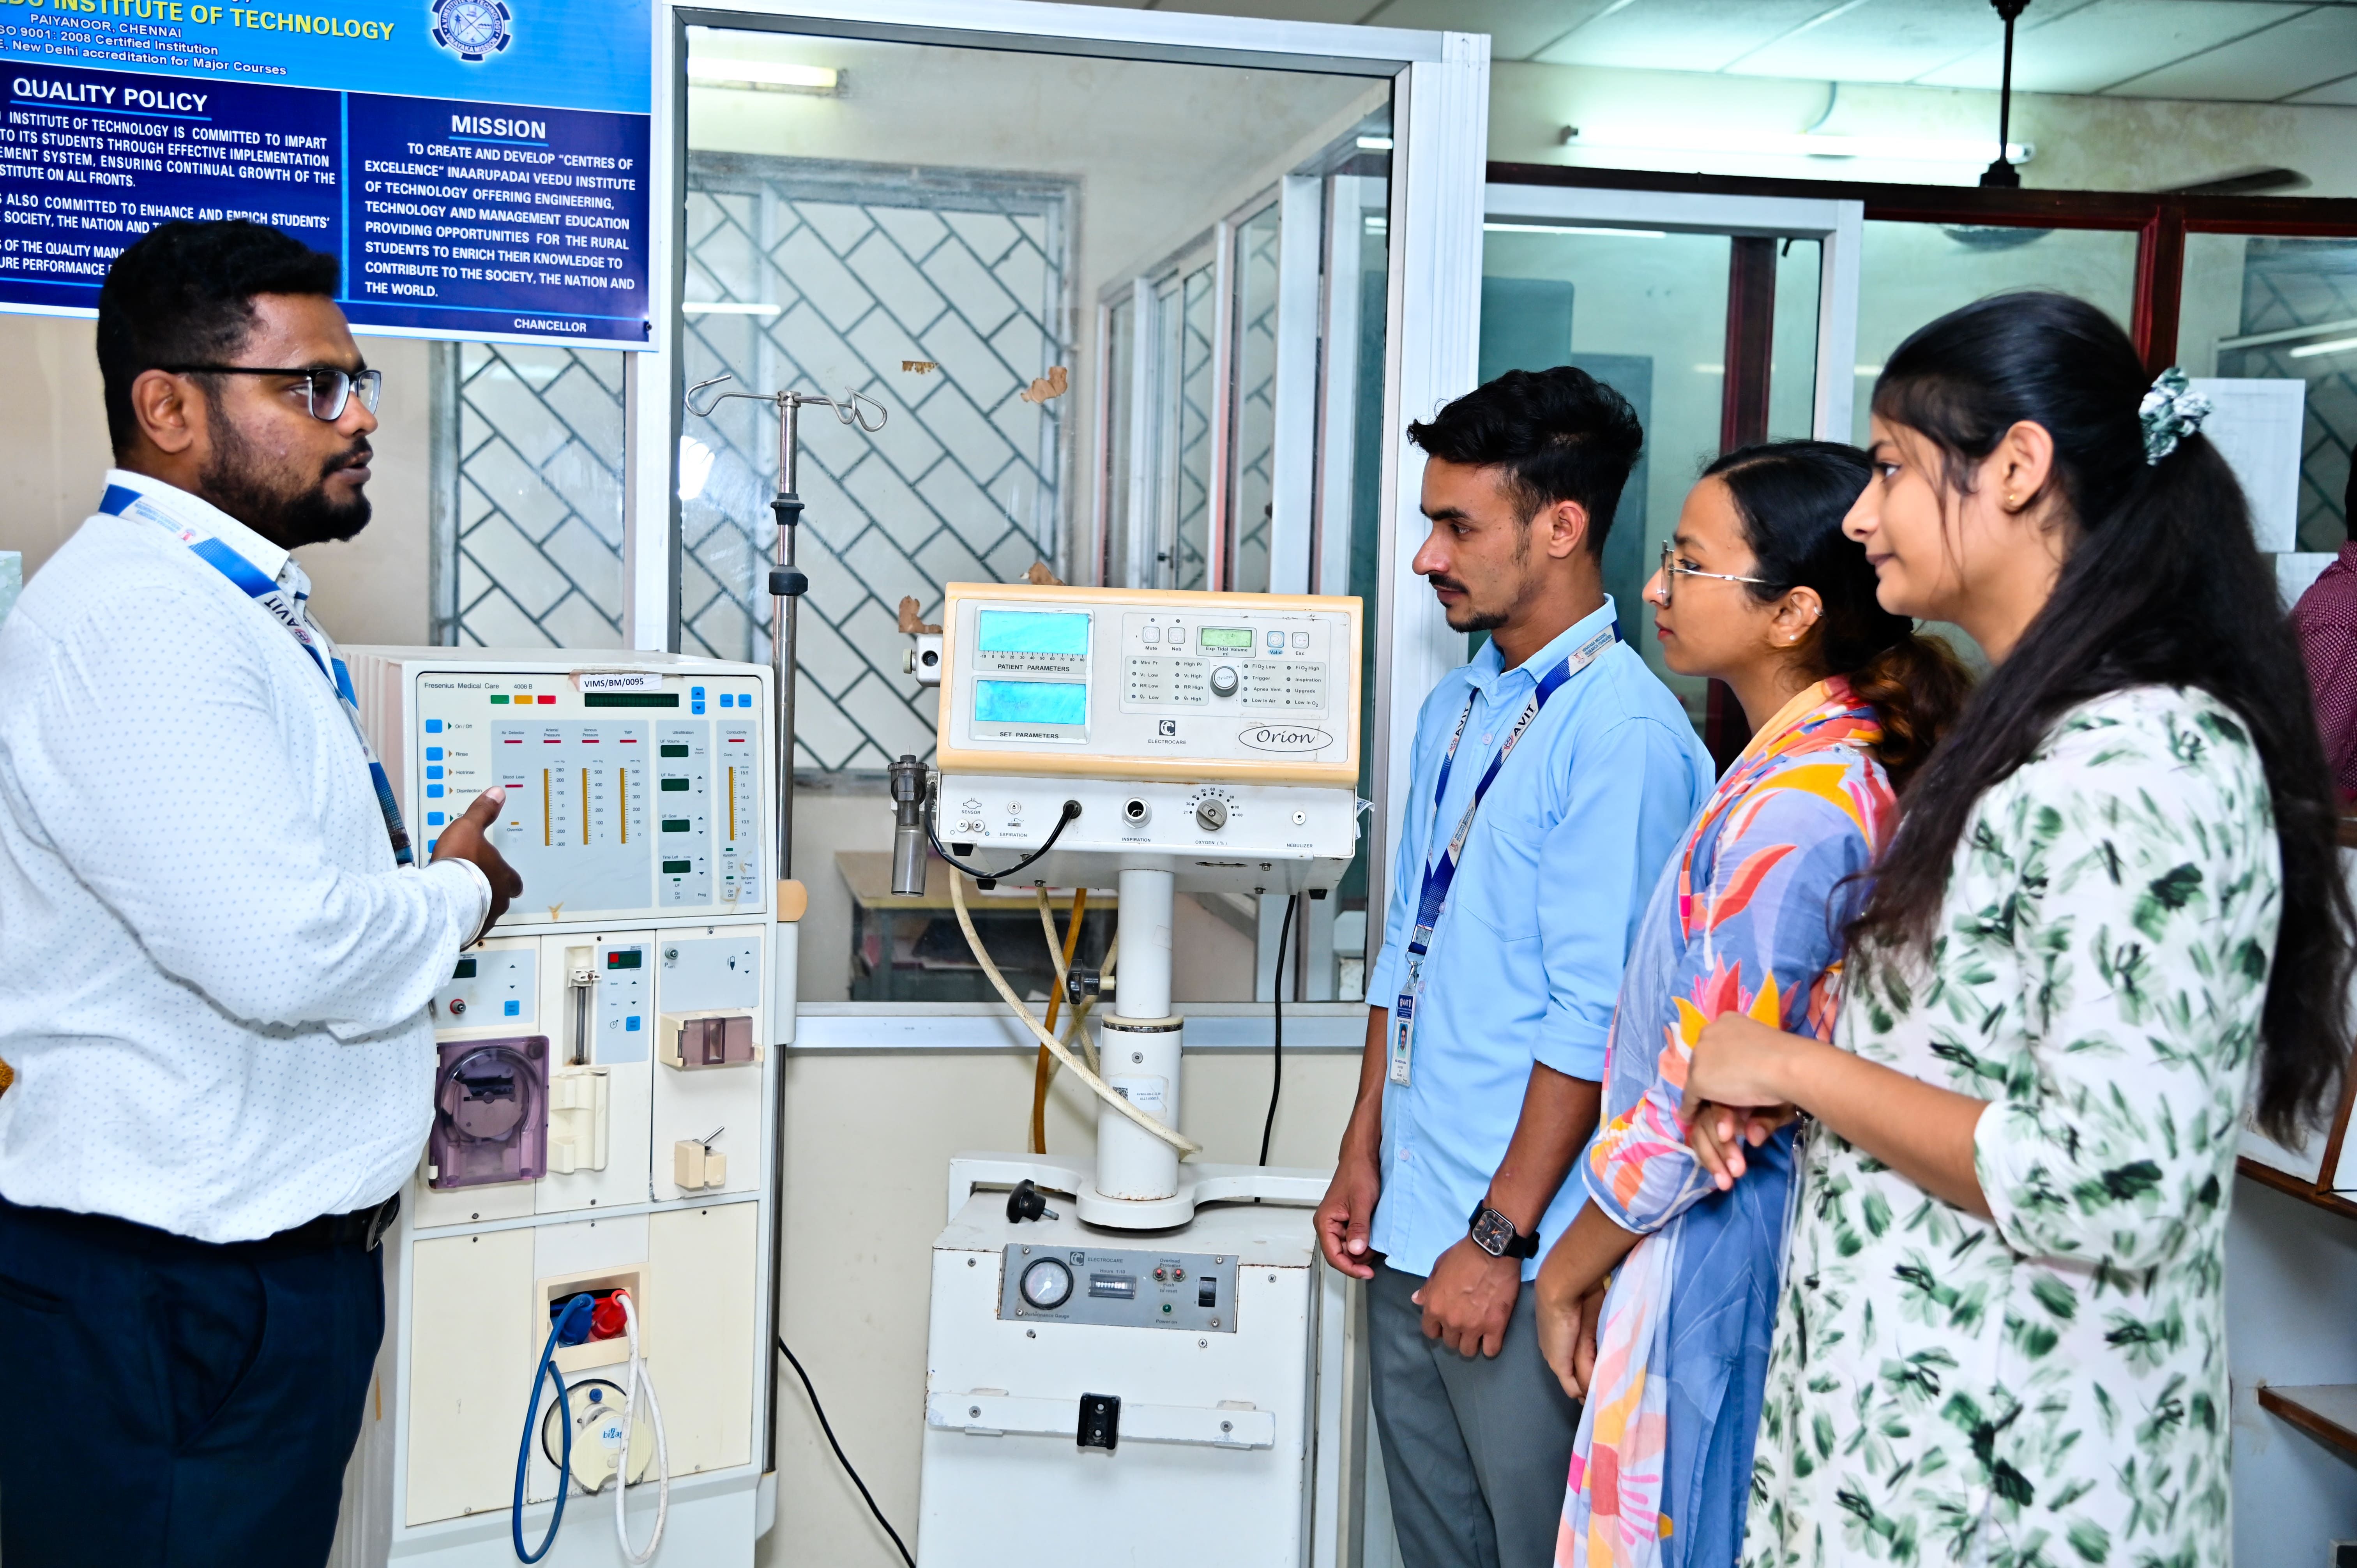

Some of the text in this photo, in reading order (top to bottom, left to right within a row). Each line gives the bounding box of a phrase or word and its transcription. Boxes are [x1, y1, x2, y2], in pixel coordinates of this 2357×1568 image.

[31, 14, 181, 37] PAIYANOOR, CHENNAI
[191, 4, 395, 41] OF TECHNOLOGY
[21, 28, 217, 55] 9001: 2008 Certified Institution
[445, 33, 474, 53] VINAYAKA
[474, 37, 498, 53] MISSION
[13, 41, 286, 74] New Delhi accreditation for Major Courses
[13, 78, 207, 111] QUALITY POLICY
[10, 111, 327, 149] INSTITUTE OF TECHNOLOGY IS COMMITTED TO IMPART
[452, 115, 546, 139] MISSION
[19, 131, 329, 167] ITS STUDENTS THROUGH EFFECTIVE IMPLEMENTATION
[407, 143, 424, 155] TO
[427, 144, 472, 159] CREATE
[475, 148, 500, 161] AND
[504, 150, 555, 164] DEVELOP
[618, 158, 633, 170] OF
[448, 166, 530, 183] INAARUPADAI
[533, 173, 572, 186] VEEDU
[576, 176, 635, 191] INSTITUTE
[365, 181, 614, 210] OF TECHNOLOGY OFFERING ENGINEERING,
[365, 201, 629, 230] TECHNOLOGY AND MANAGEMENT EDUCATION
[366, 221, 629, 250] PROVIDING OPPORTUNITIES FOR THE RURAL
[366, 241, 623, 269] STUDENTS TO ENRICH THEIR KNOWLEDGE TO
[365, 261, 635, 290] CONTRIBUTE TO THE SOCIETY, THE NATION AND
[365, 281, 438, 297] THE WORLD.
[514, 318, 587, 332] CHANCELLOR
[264, 597, 300, 627] AVIT
[584, 678, 644, 688] VIMS/BM/0095
[1514, 704, 1534, 736] AVIT
[1256, 729, 1315, 743] Orion
